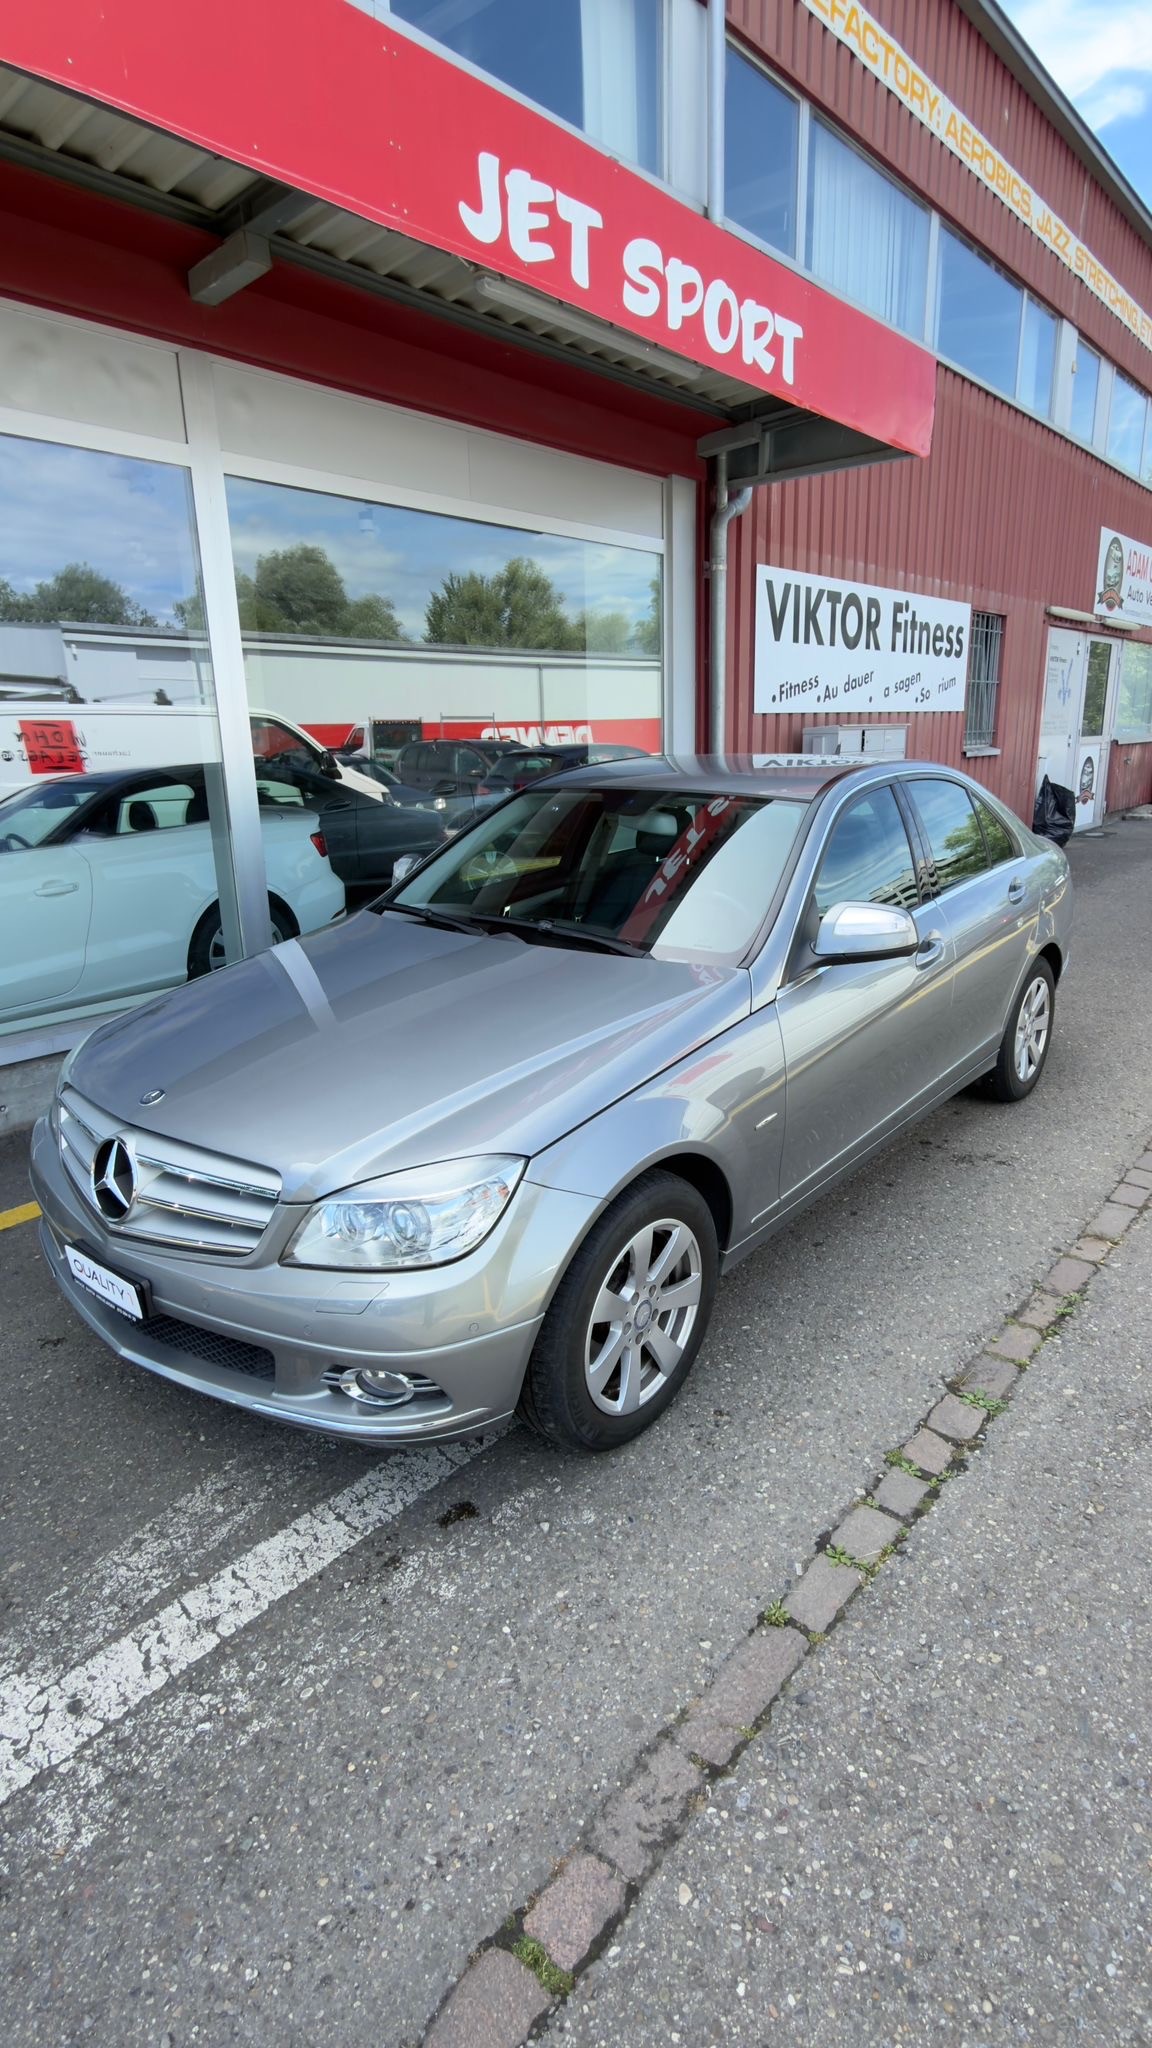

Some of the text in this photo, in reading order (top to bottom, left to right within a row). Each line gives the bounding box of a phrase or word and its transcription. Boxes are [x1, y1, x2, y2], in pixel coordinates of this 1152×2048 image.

[458, 151, 803, 385] JET SPORT
[1126, 549, 1149, 581] ADAM
[1127, 585, 1143, 603] Auto
[765, 579, 964, 659] VIKTOR Fitness
[779, 675, 819, 703] Fitness
